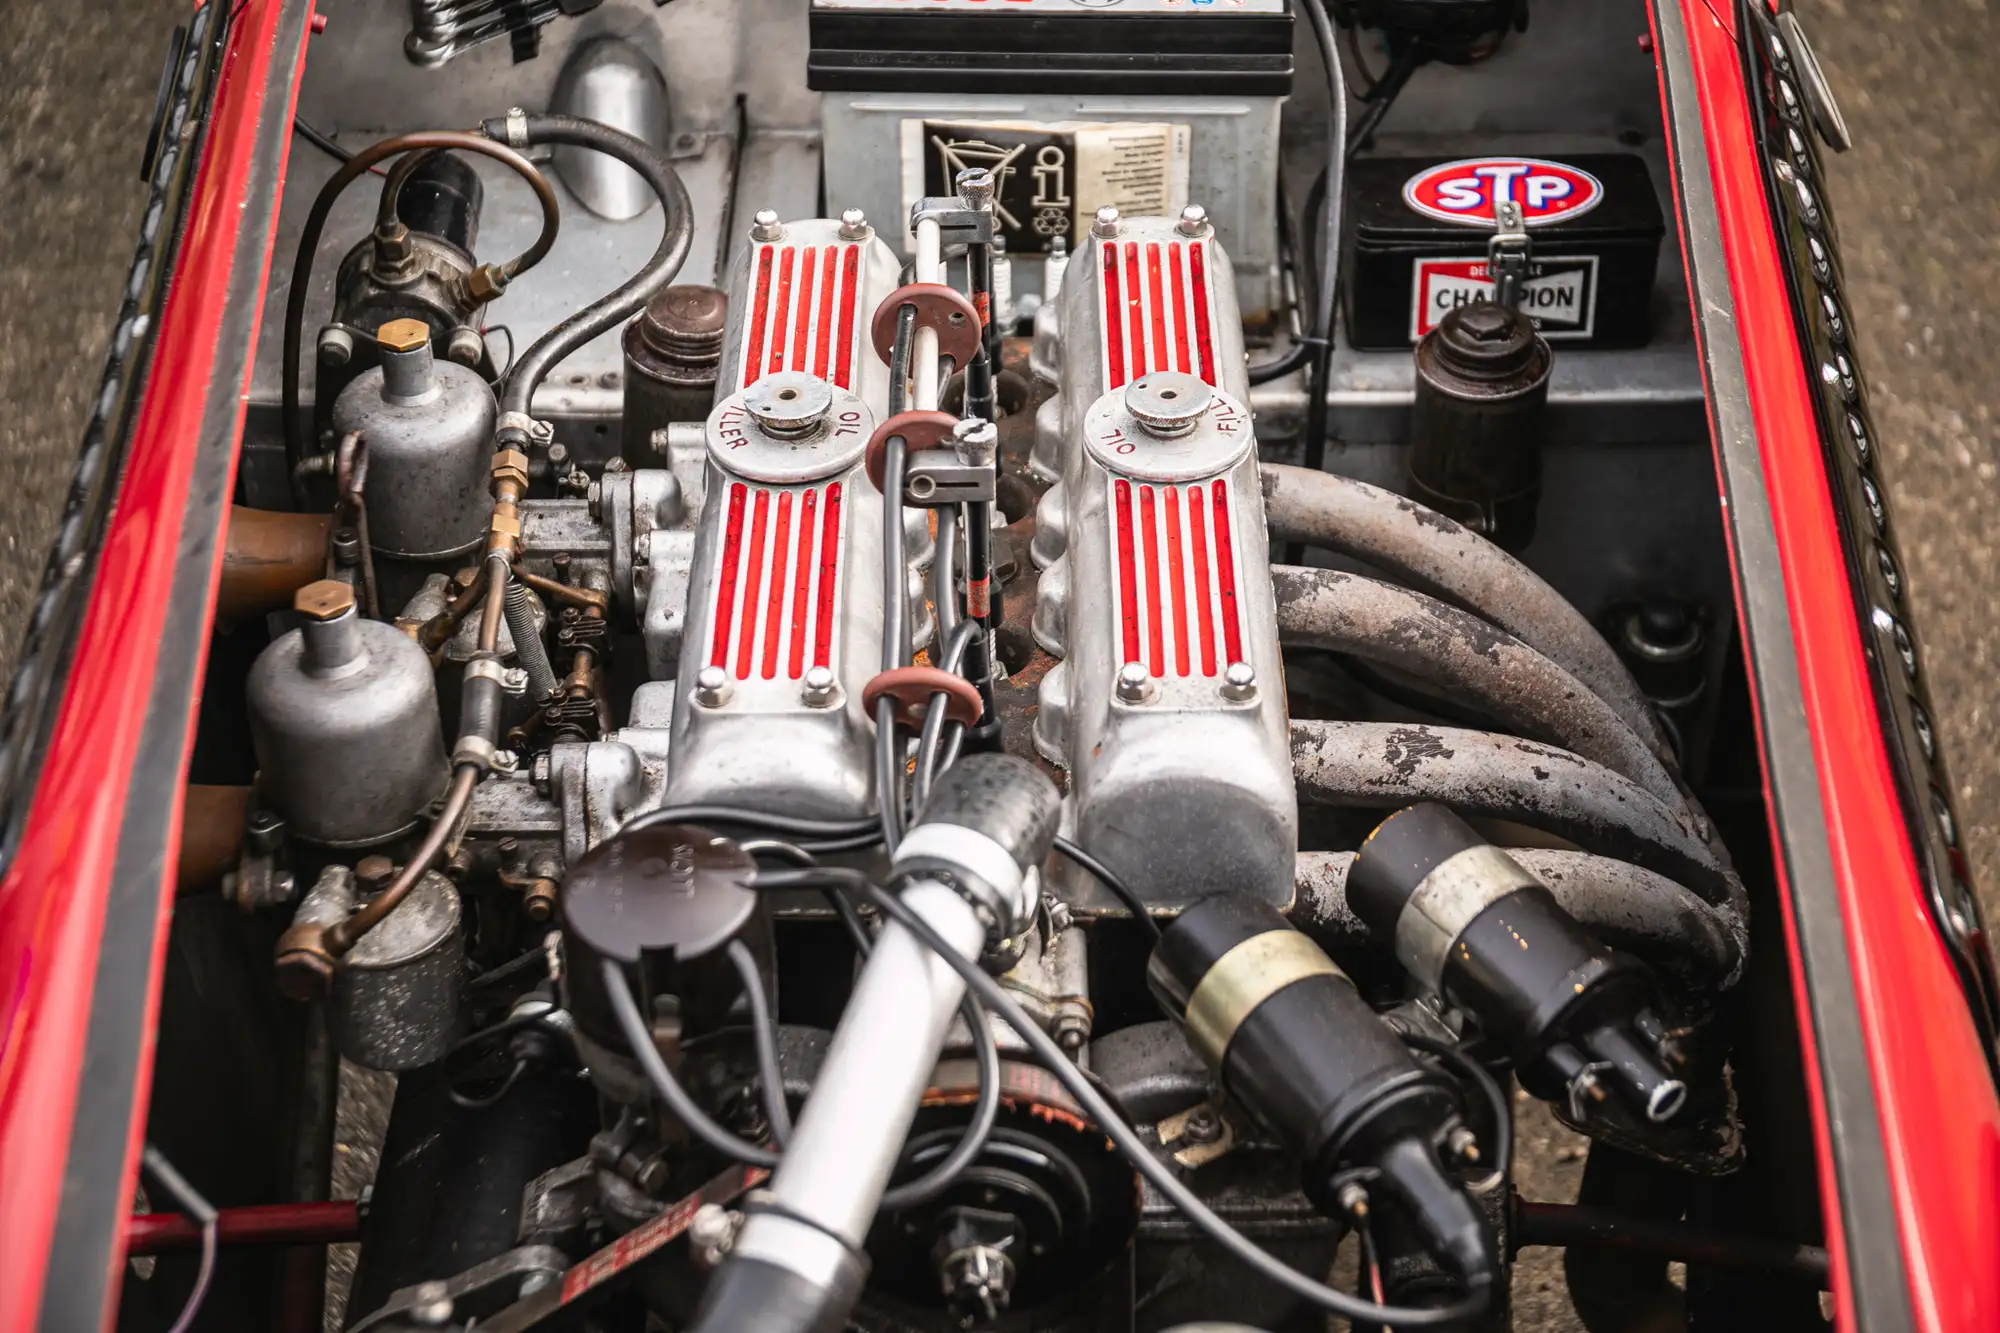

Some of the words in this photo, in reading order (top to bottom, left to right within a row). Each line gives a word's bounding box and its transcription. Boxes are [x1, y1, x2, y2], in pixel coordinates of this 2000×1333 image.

[1436, 165, 1574, 209] STP
[1436, 286, 1574, 309] CHAPION
[719, 405, 749, 450] ILLER
[835, 411, 861, 437] OIL
[1101, 428, 1136, 455] OIL
